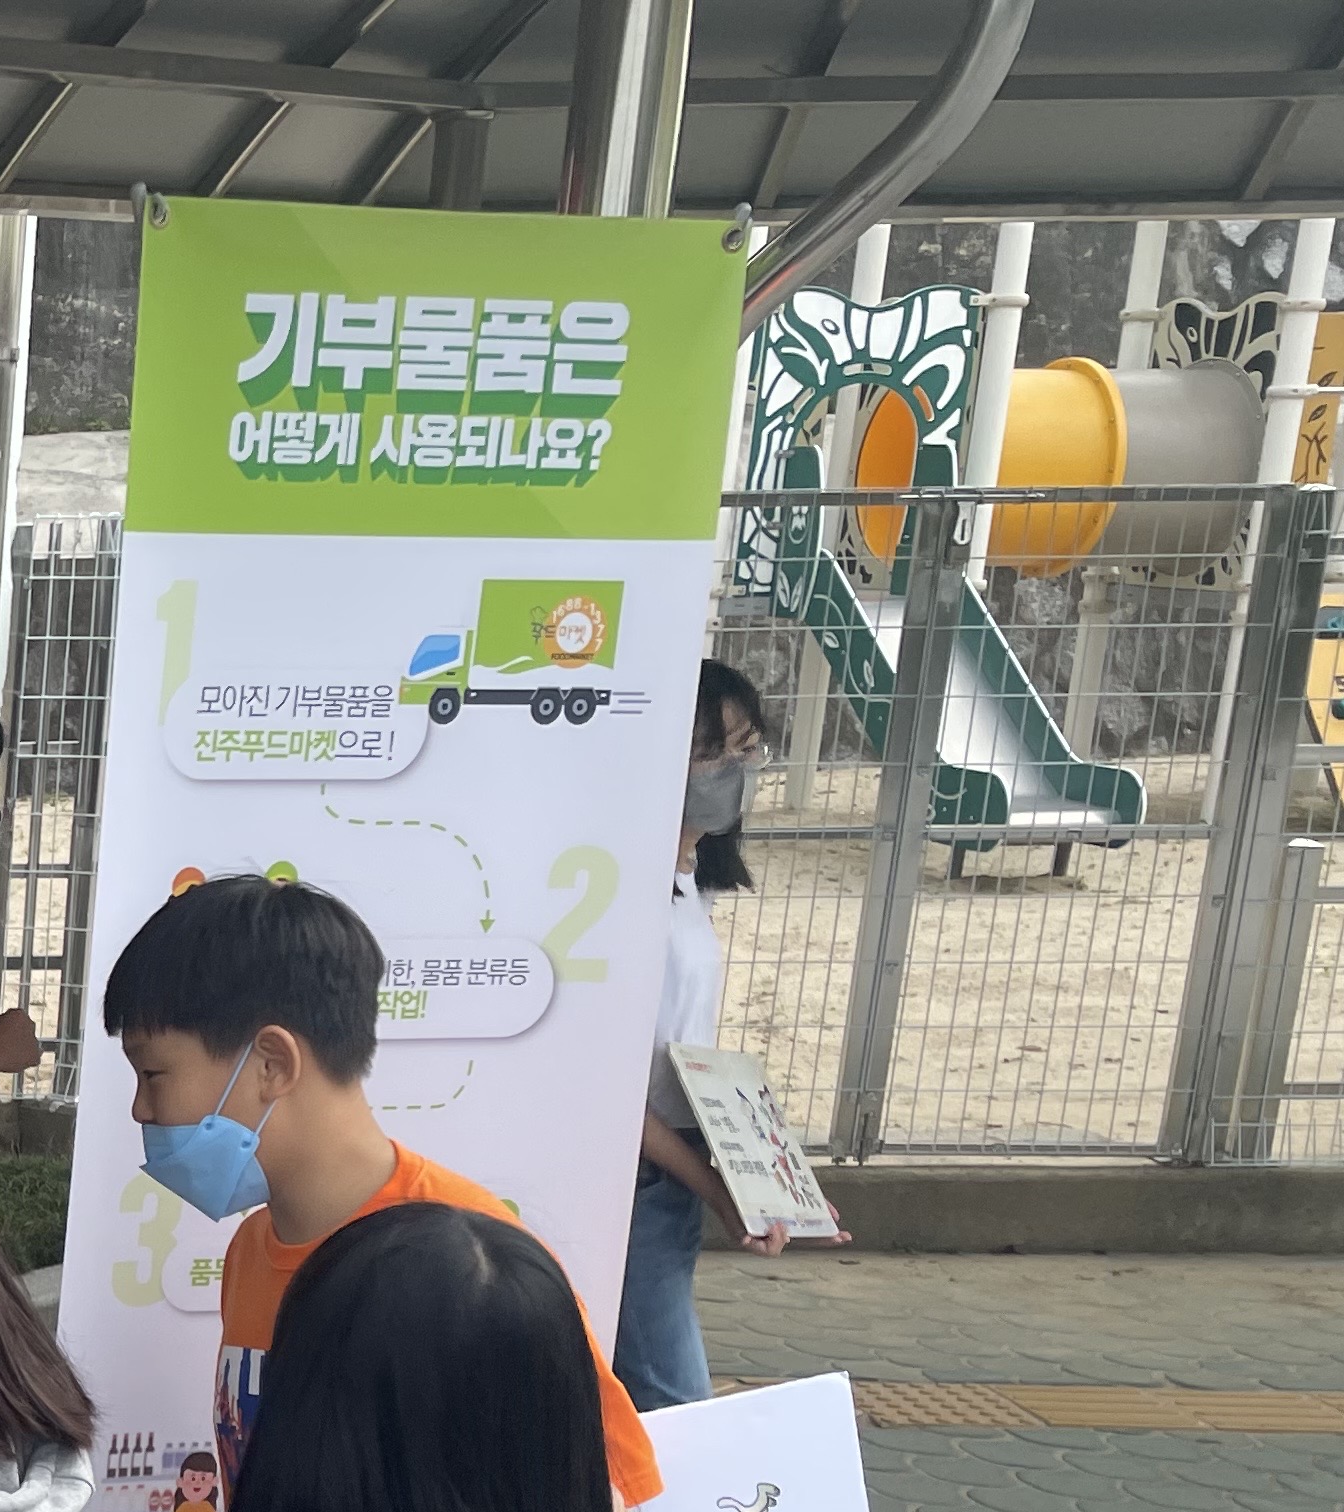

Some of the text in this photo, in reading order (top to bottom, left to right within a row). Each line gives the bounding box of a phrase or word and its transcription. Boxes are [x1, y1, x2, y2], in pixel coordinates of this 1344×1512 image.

[236, 291, 631, 396] 기부물품은
[228, 411, 612, 472] 어떻게 사용되나요?
[196, 685, 395, 718] 모아진 기부물품을
[193, 729, 395, 763] 진주푸드마켓으로!
[546, 845, 620, 984] 2
[385, 959, 415, 989] 한,
[421, 958, 464, 987] 물품
